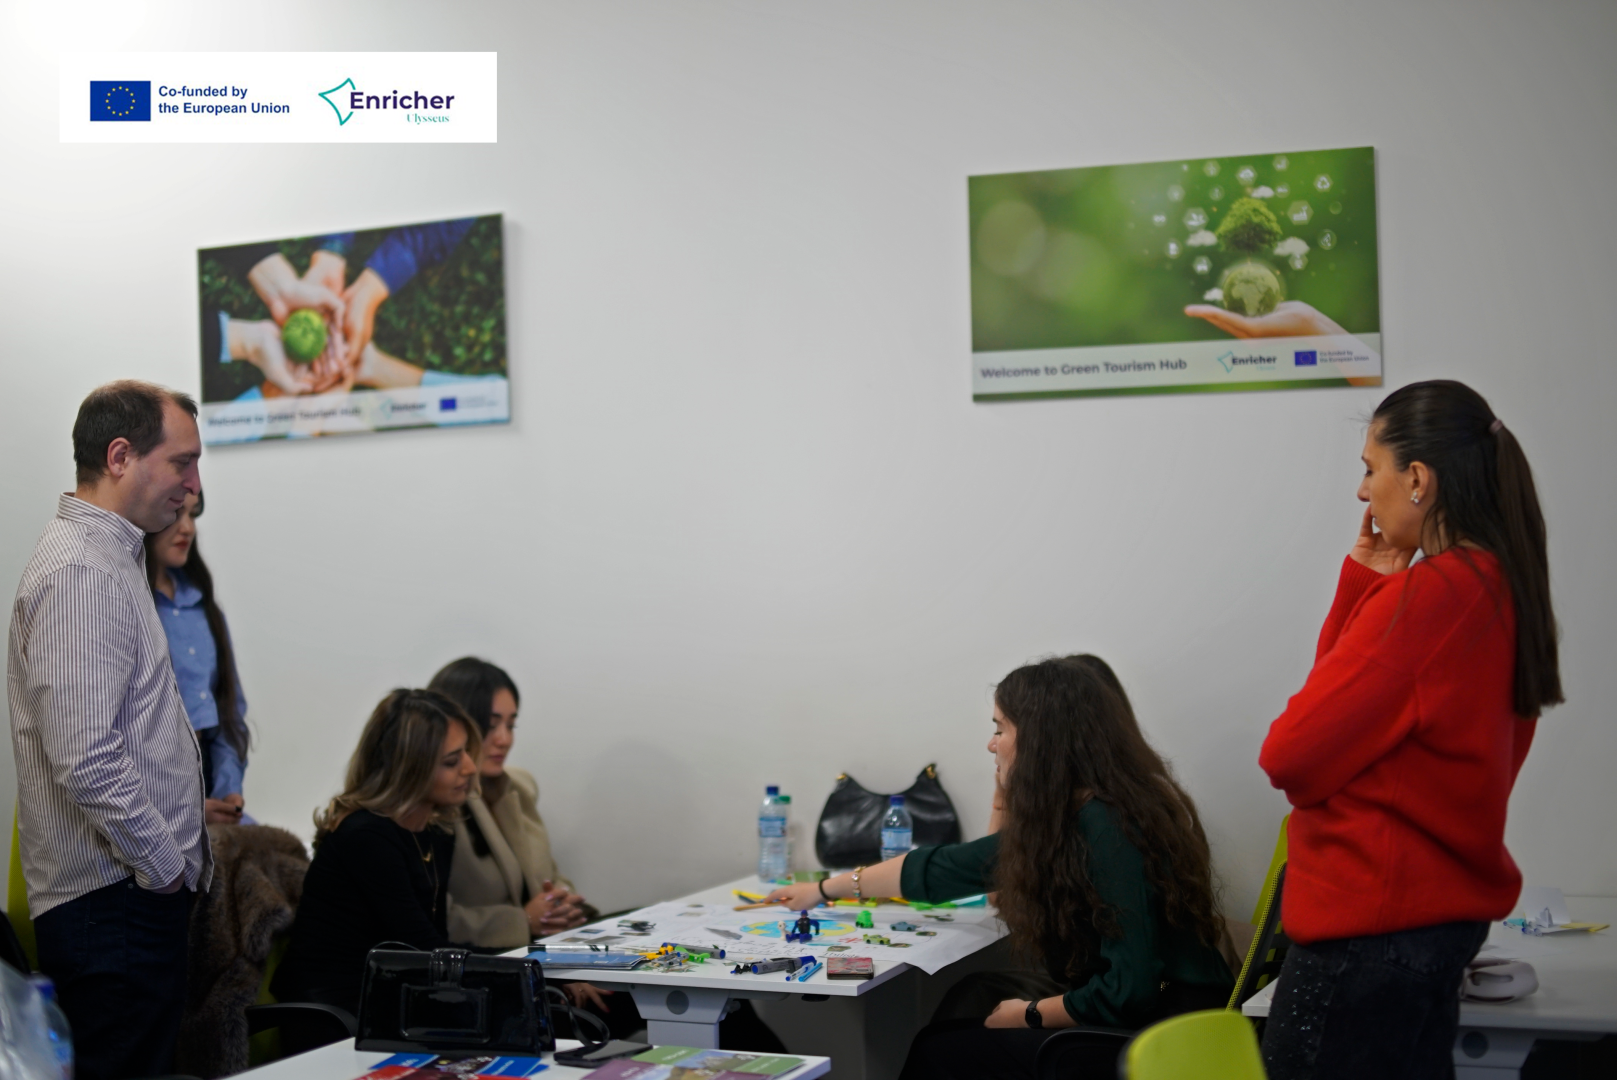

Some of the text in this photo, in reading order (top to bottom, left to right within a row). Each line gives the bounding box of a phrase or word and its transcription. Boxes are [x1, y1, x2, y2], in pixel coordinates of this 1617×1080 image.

[1231, 354, 1277, 366] Enricher
[980, 358, 1188, 379] Welcome to Green Tourism Hub
